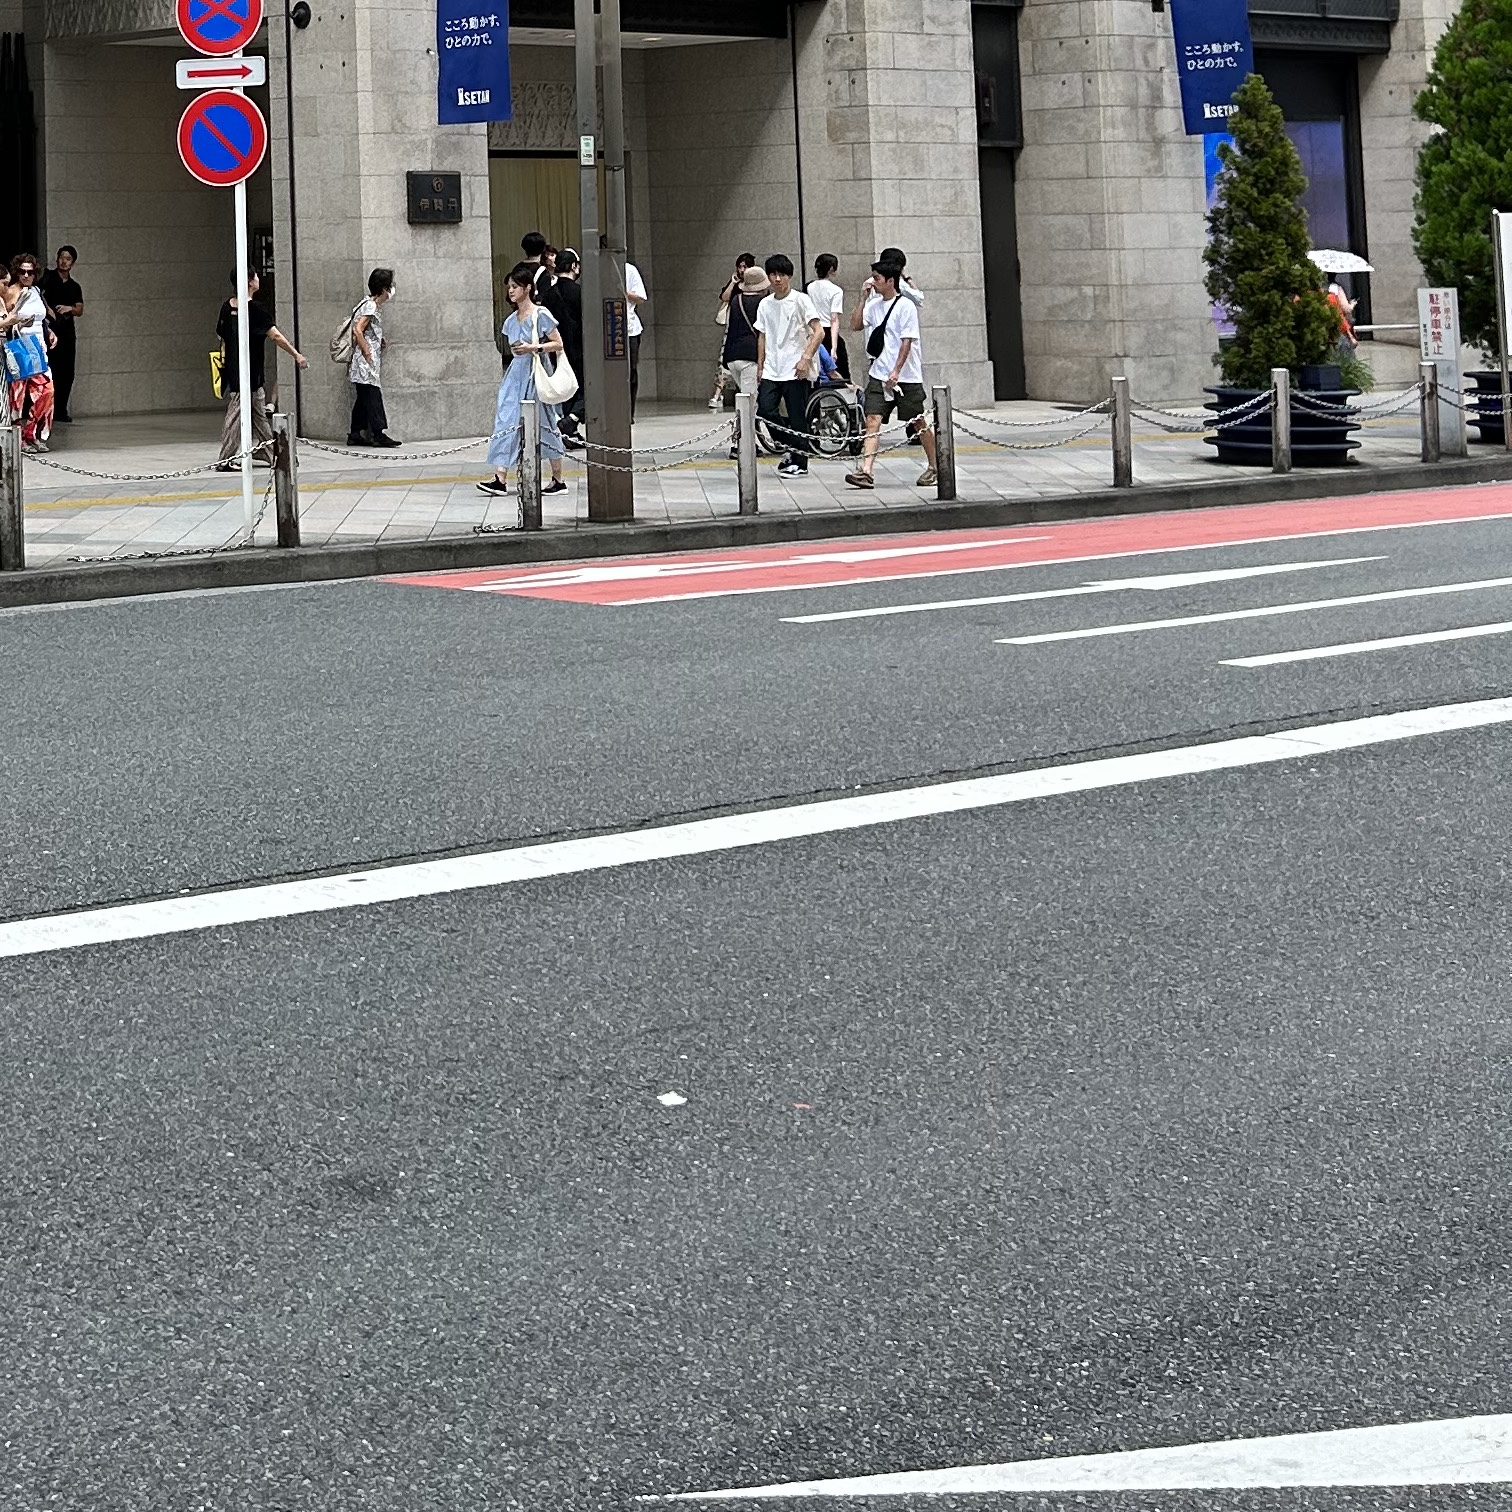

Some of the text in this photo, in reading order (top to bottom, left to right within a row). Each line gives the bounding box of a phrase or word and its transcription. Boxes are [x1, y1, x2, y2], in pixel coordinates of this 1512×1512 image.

[445, 33, 493, 49] ひとの力で。
[1428, 293, 1444, 356] 駐停車禁止
